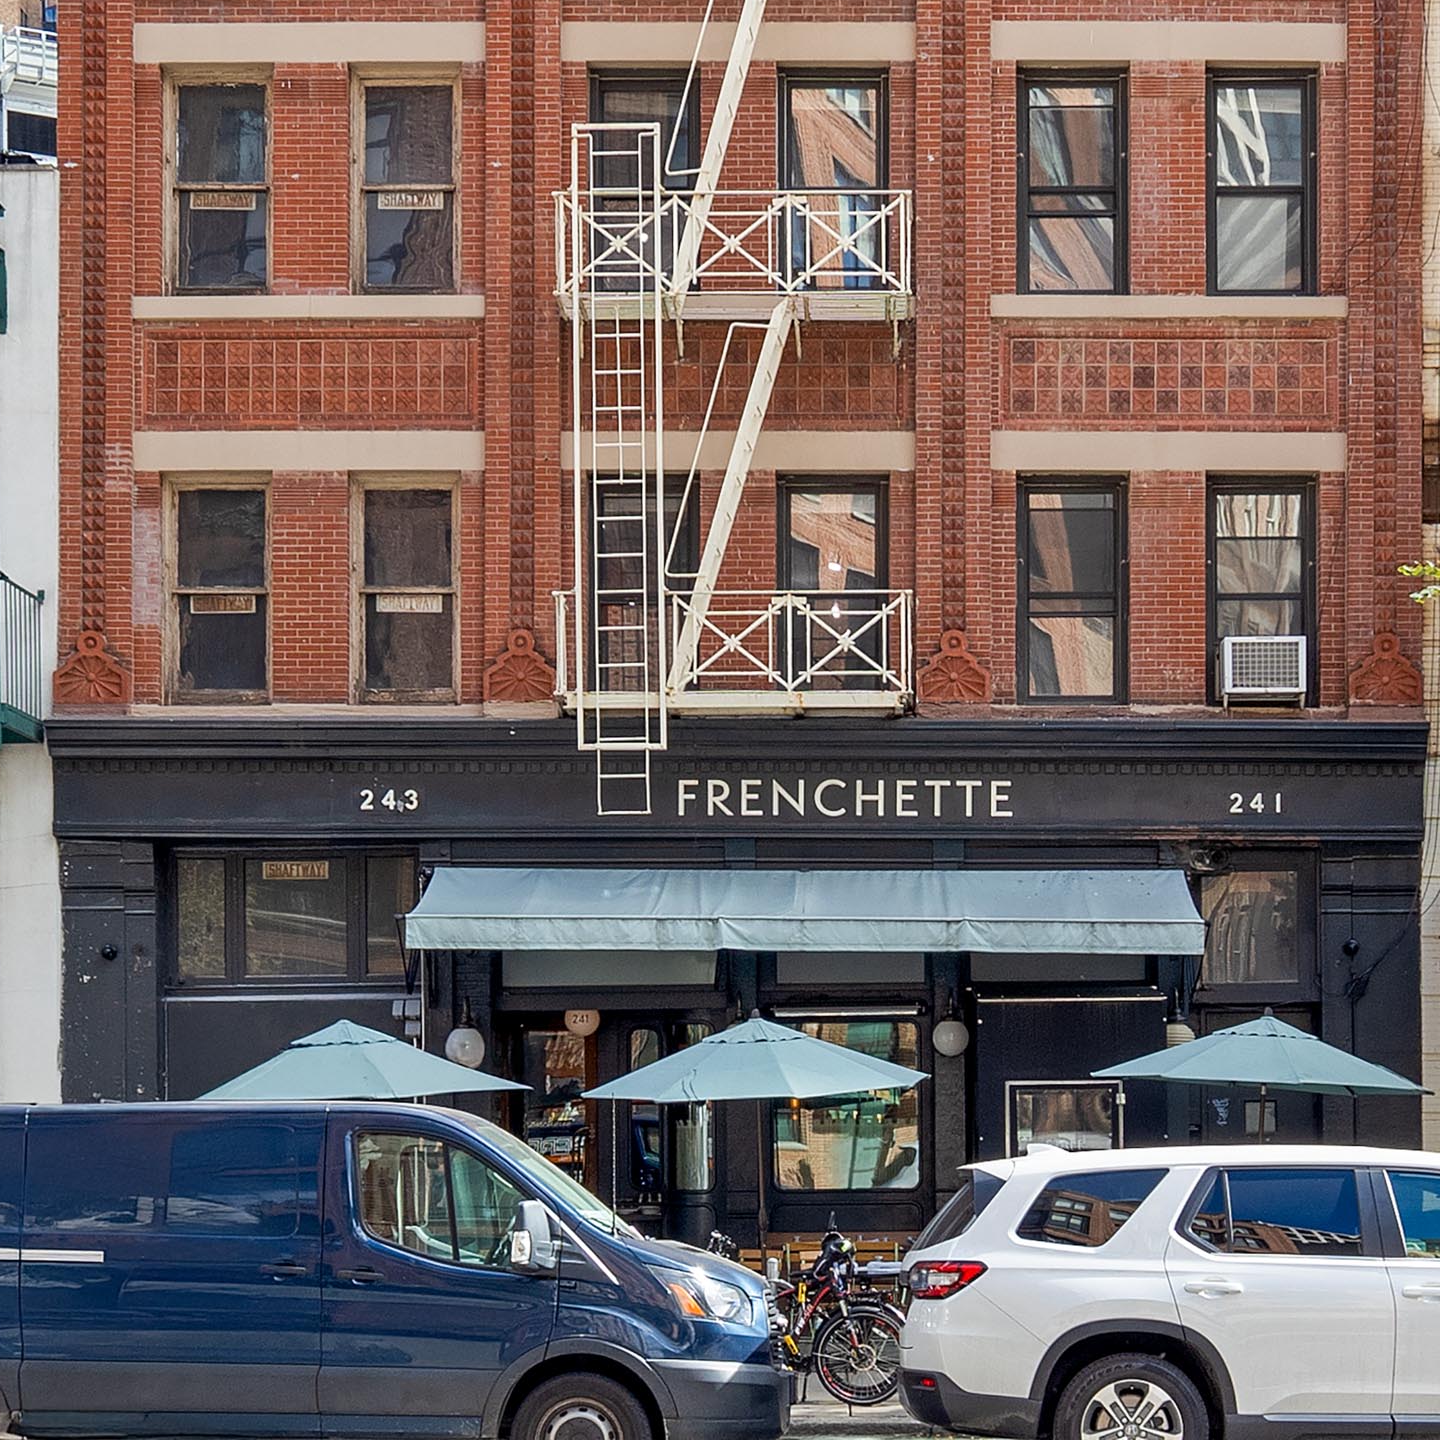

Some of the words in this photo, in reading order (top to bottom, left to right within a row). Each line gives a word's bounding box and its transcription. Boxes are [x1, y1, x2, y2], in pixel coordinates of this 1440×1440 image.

[360, 789, 418, 810] 243
[677, 778, 1013, 818] FRENCHETTE
[1229, 792, 1281, 814] 241
[268, 863, 323, 877] SHAFTWAY
